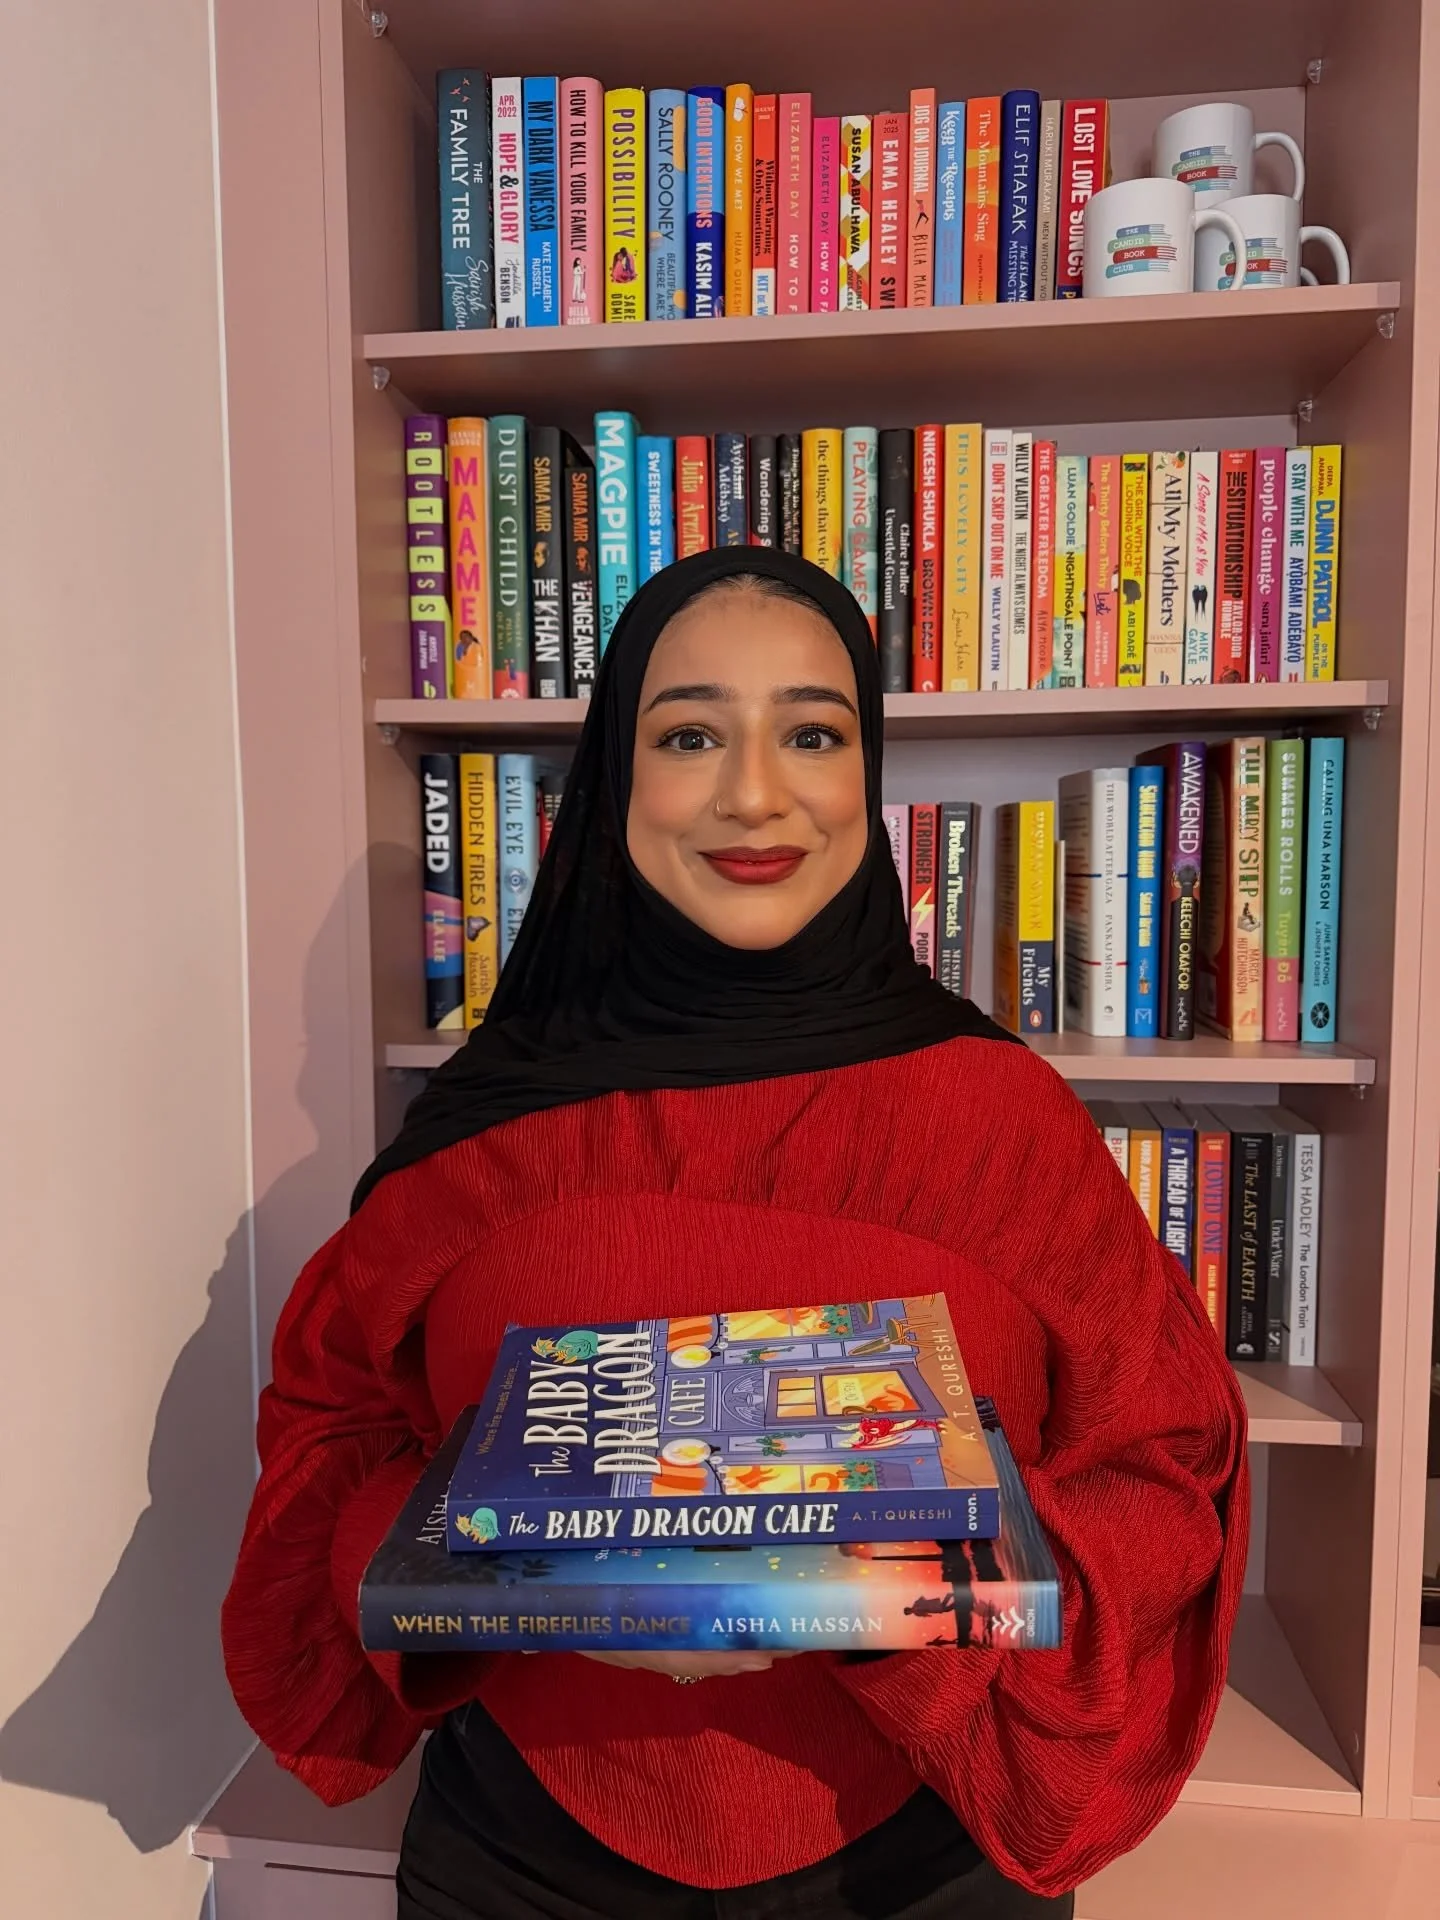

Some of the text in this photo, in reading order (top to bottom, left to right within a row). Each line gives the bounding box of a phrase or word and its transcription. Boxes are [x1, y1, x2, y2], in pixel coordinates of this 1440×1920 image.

[497, 107, 517, 119] 2022
[499, 95, 514, 107] APR
[978, 110, 991, 137] The
[450, 108, 471, 249] FAMILY TREE
[498, 132, 519, 244] HOPE & GLORY
[527, 100, 556, 232] MY DARK VANESSA
[570, 89, 588, 252] HOW TO KILL YOUR FAMILY
[612, 108, 635, 239] POSSIBILITY
[657, 107, 675, 242] SALLY ROONEY
[850, 128, 862, 254] SUSAN ABULHAWA
[976, 141, 990, 210] Mountains
[1012, 104, 1031, 235] ELIF SHAFAK
[1071, 107, 1097, 204] LOST LOVE
[1186, 171, 1207, 180] BOOK
[789, 102, 800, 295] ELIZABETH HOW TO
[881, 140, 898, 264] EMMA HEALEY
[974, 212, 988, 242] Sing
[532, 257, 542, 297] RUSSELL
[542, 241, 552, 264] KATE
[695, 242, 712, 317] KASIM ALI
[820, 242, 829, 295] HOW TO
[1112, 264, 1134, 274] CLUB
[1113, 237, 1145, 250] CANDID
[1123, 249, 1145, 259] BOOK
[498, 428, 519, 506] DUST
[533, 457, 553, 533] SAIMA MIR
[600, 418, 629, 567] MAGPIE
[648, 452, 661, 545] SWEETNESS IN
[758, 458, 771, 533] Wandering
[853, 441, 868, 527] PLAYING
[1014, 442, 1030, 520] WILLY VLAUTIN
[1164, 473, 1182, 502] All
[899, 523, 910, 559] Claire
[922, 430, 937, 618] NIKESH SHUKLA BROWN
[991, 497, 1005, 579] SKIP OUT ON ME
[1037, 448, 1051, 599] THE GREATER FREEDOM
[1066, 467, 1077, 545] LUAN GOLDIE
[1099, 519, 1110, 555] Before
[1124, 483, 1134, 568] LOUDING VOICE
[1133, 475, 1144, 577] THE GIRL WITH THE
[1158, 505, 1181, 540] My
[1223, 487, 1246, 599] SITUATIONSHIP
[1258, 459, 1278, 596] people change
[1290, 463, 1306, 548] STAY WITH ME
[498, 516, 519, 607] CHILD
[884, 508, 896, 611] Unsettled Ground
[1014, 531, 1027, 571] THE NIGHT
[1159, 545, 1180, 627] Mothers
[1312, 499, 1336, 629] DJINN PATROL
[533, 600, 560, 663] KHAN
[572, 518, 595, 680] MIR VENGEANCE
[991, 587, 1002, 671] WILLY VLAUTIN
[1063, 551, 1075, 667] NIGHTINGALE POINT
[1127, 610, 1137, 627] ABI
[1187, 628, 1198, 665] GAYLE
[1199, 631, 1209, 662] MIKE
[424, 772, 450, 874] JADED
[467, 772, 487, 907] HIDDEN FIRES
[1178, 752, 1203, 854] AWAKENED
[1279, 752, 1297, 897] SUMMER ROLLS
[915, 811, 934, 885] STRONGER
[945, 820, 966, 939] Broken Threads
[1104, 805, 1114, 904] WORLD GAZA
[1319, 821, 1334, 911] UNA MARSON
[433, 939, 446, 963] LEE
[1179, 896, 1193, 940] KELECHI
[1021, 947, 1036, 1006] Friends
[1036, 966, 1051, 988] My
[1177, 942, 1192, 991] OKAFOR
[1236, 937, 1248, 995] HUTCHINSON
[1249, 949, 1260, 984] MARCIA
[1166, 1147, 1188, 1218] A THREAD OF
[1202, 1160, 1225, 1255] LOVED ONE
[1243, 1189, 1258, 1229] LAST
[1245, 1162, 1258, 1186] The
[1299, 1143, 1314, 1238] TESSA HADLEY
[1240, 1231, 1256, 1244] of
[1240, 1246, 1256, 1301] EARTH
[1299, 1243, 1311, 1260] The
[1298, 1304, 1309, 1329] Train
[1299, 1265, 1310, 1302] London
[523, 1360, 589, 1479] The BABY
[592, 1331, 662, 1475] DRAGON
[668, 1376, 706, 1426] CAFE
[932, 1328, 978, 1442] A. T. QURESHI
[509, 1503, 839, 1539] The BABY DRAGON CAFE
[392, 1613, 692, 1635] WHEN THE FIREFLIES DANCE
[711, 1616, 884, 1634] AISHA HASSAN
[1027, 1608, 1037, 1637] ORION
